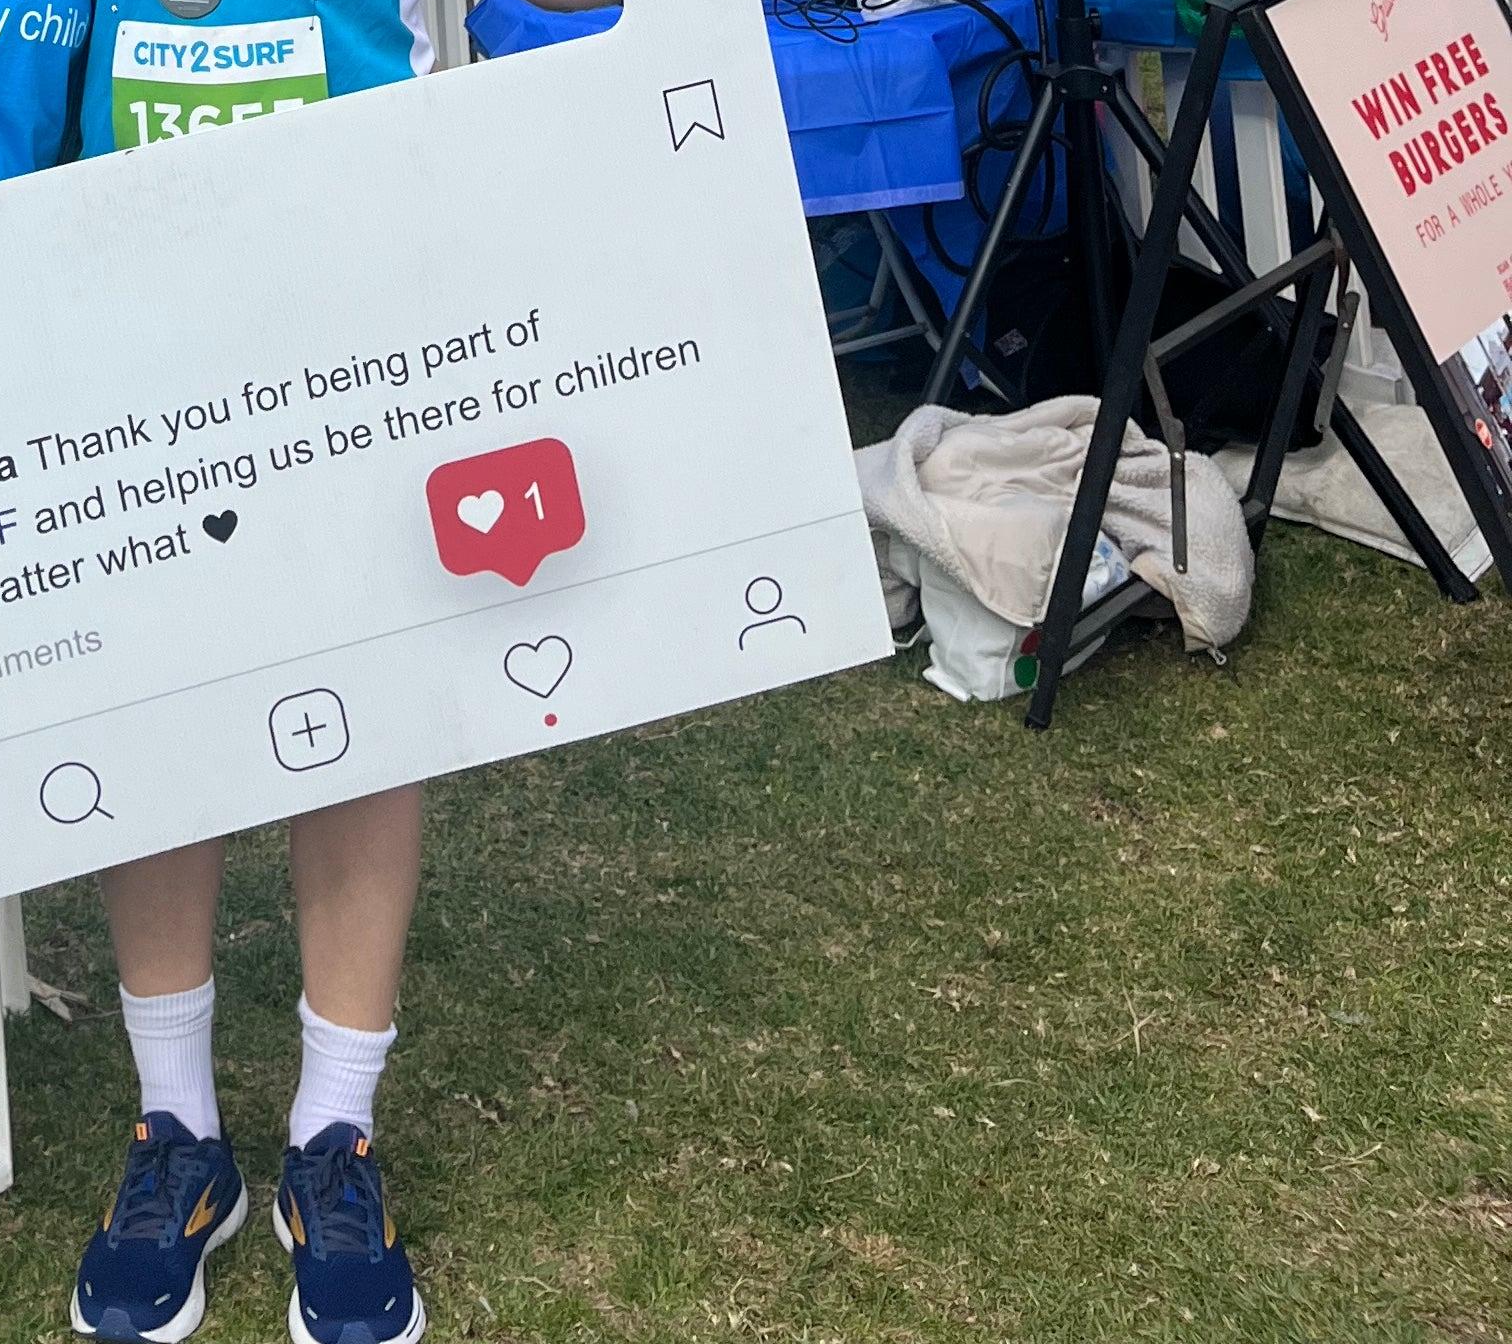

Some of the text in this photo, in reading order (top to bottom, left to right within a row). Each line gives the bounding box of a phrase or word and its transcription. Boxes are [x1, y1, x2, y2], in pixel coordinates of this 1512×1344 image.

[1352, 33, 1489, 141] WIN FREE
[1389, 92, 1508, 197] BURGERS
[1416, 174, 1503, 248] FOR A WHOLE
[28, 416, 152, 473] Thank
[162, 398, 233, 446] you
[242, 379, 292, 415] for
[304, 349, 409, 400] being
[422, 324, 496, 377] part
[507, 308, 541, 348] of
[34, 486, 106, 535] and
[118, 452, 258, 515] helping
[270, 437, 315, 471] us
[325, 423, 373, 457] be
[384, 396, 482, 440] there
[492, 376, 542, 413] for
[555, 339, 701, 397] children
[96, 524, 191, 576] what
[524, 482, 545, 520] 1
